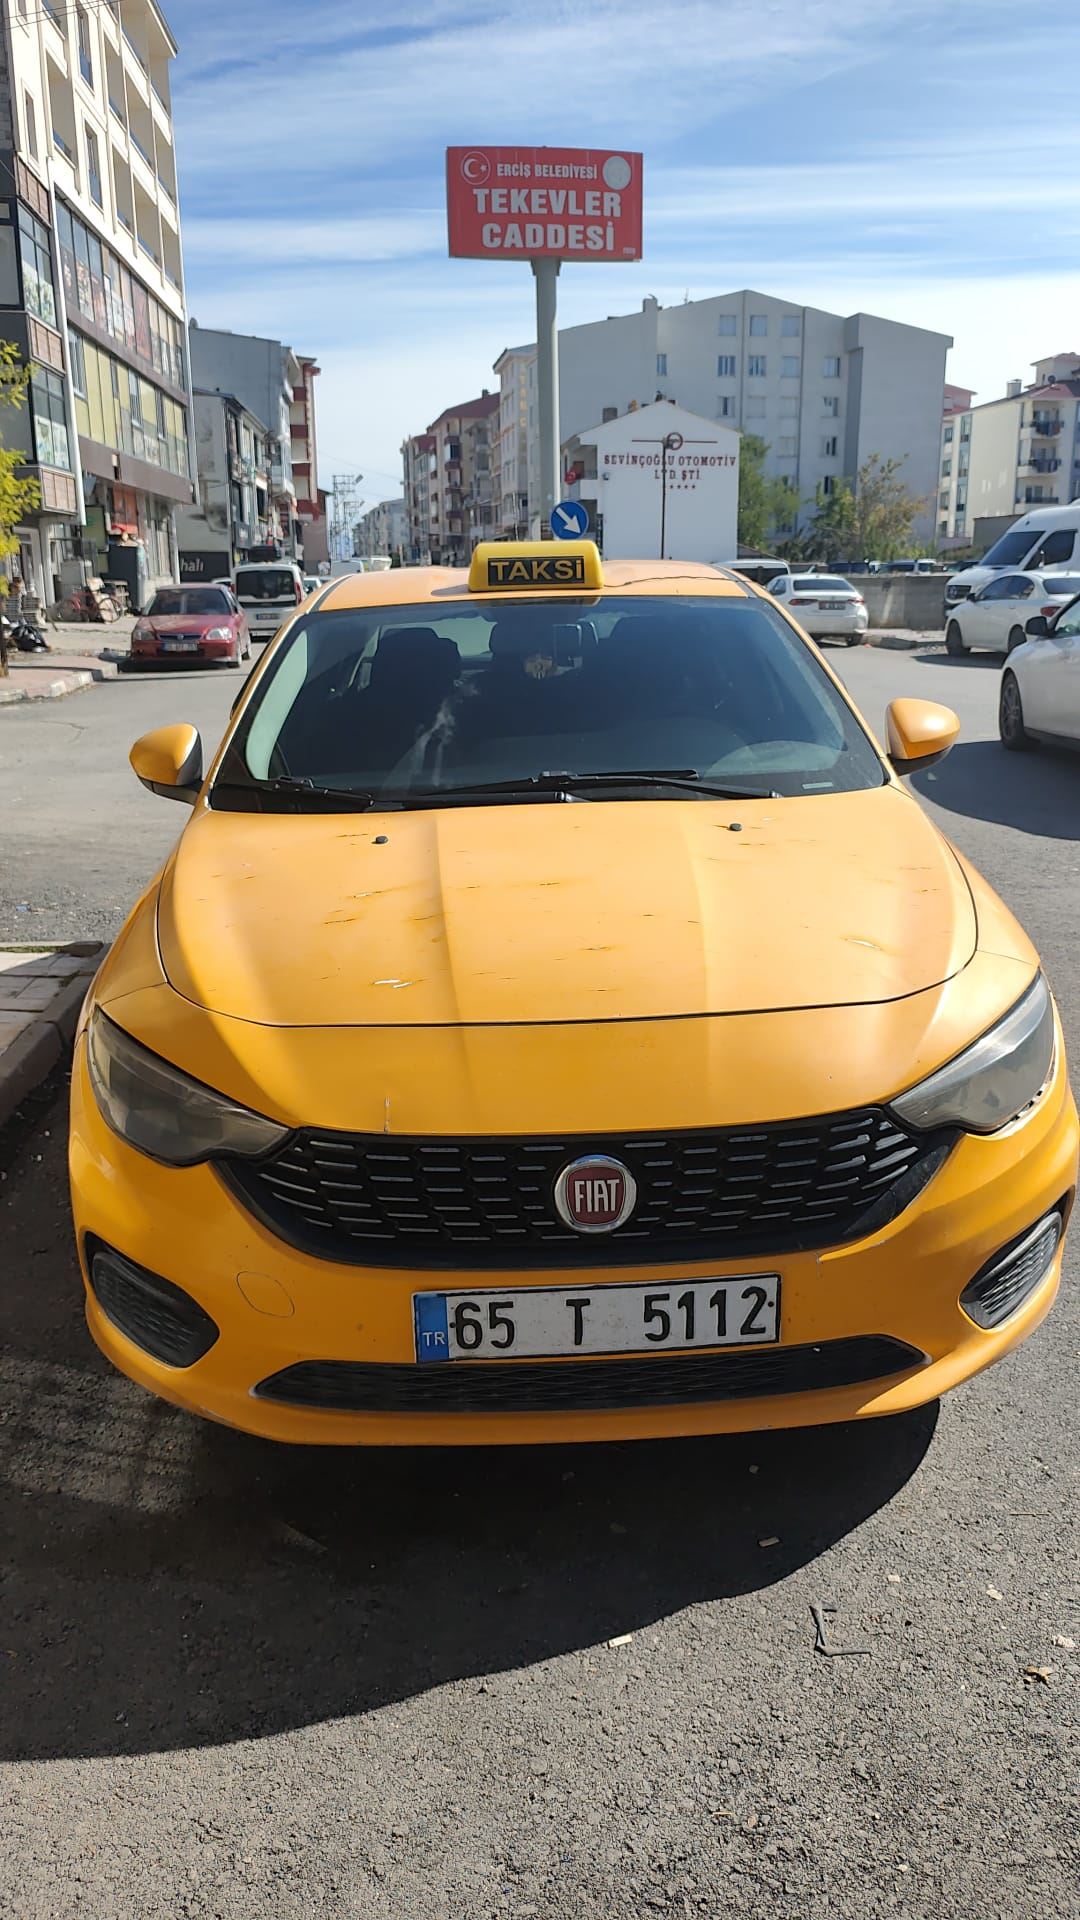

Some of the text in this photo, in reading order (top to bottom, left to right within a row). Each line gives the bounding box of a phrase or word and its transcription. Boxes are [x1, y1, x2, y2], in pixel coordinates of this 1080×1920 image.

[497, 162, 597, 179] ERCİŞ BELEDİYESİ
[473, 188, 621, 217] TEKEVLER
[482, 221, 614, 250] CADDESİ
[678, 455, 736, 467] OTOMOTİV
[681, 468, 700, 481] ŞTİ
[574, 1179, 620, 1212] FIAT
[455, 1286, 768, 1349] 65 T 5112
[422, 1331, 446, 1347] TR
